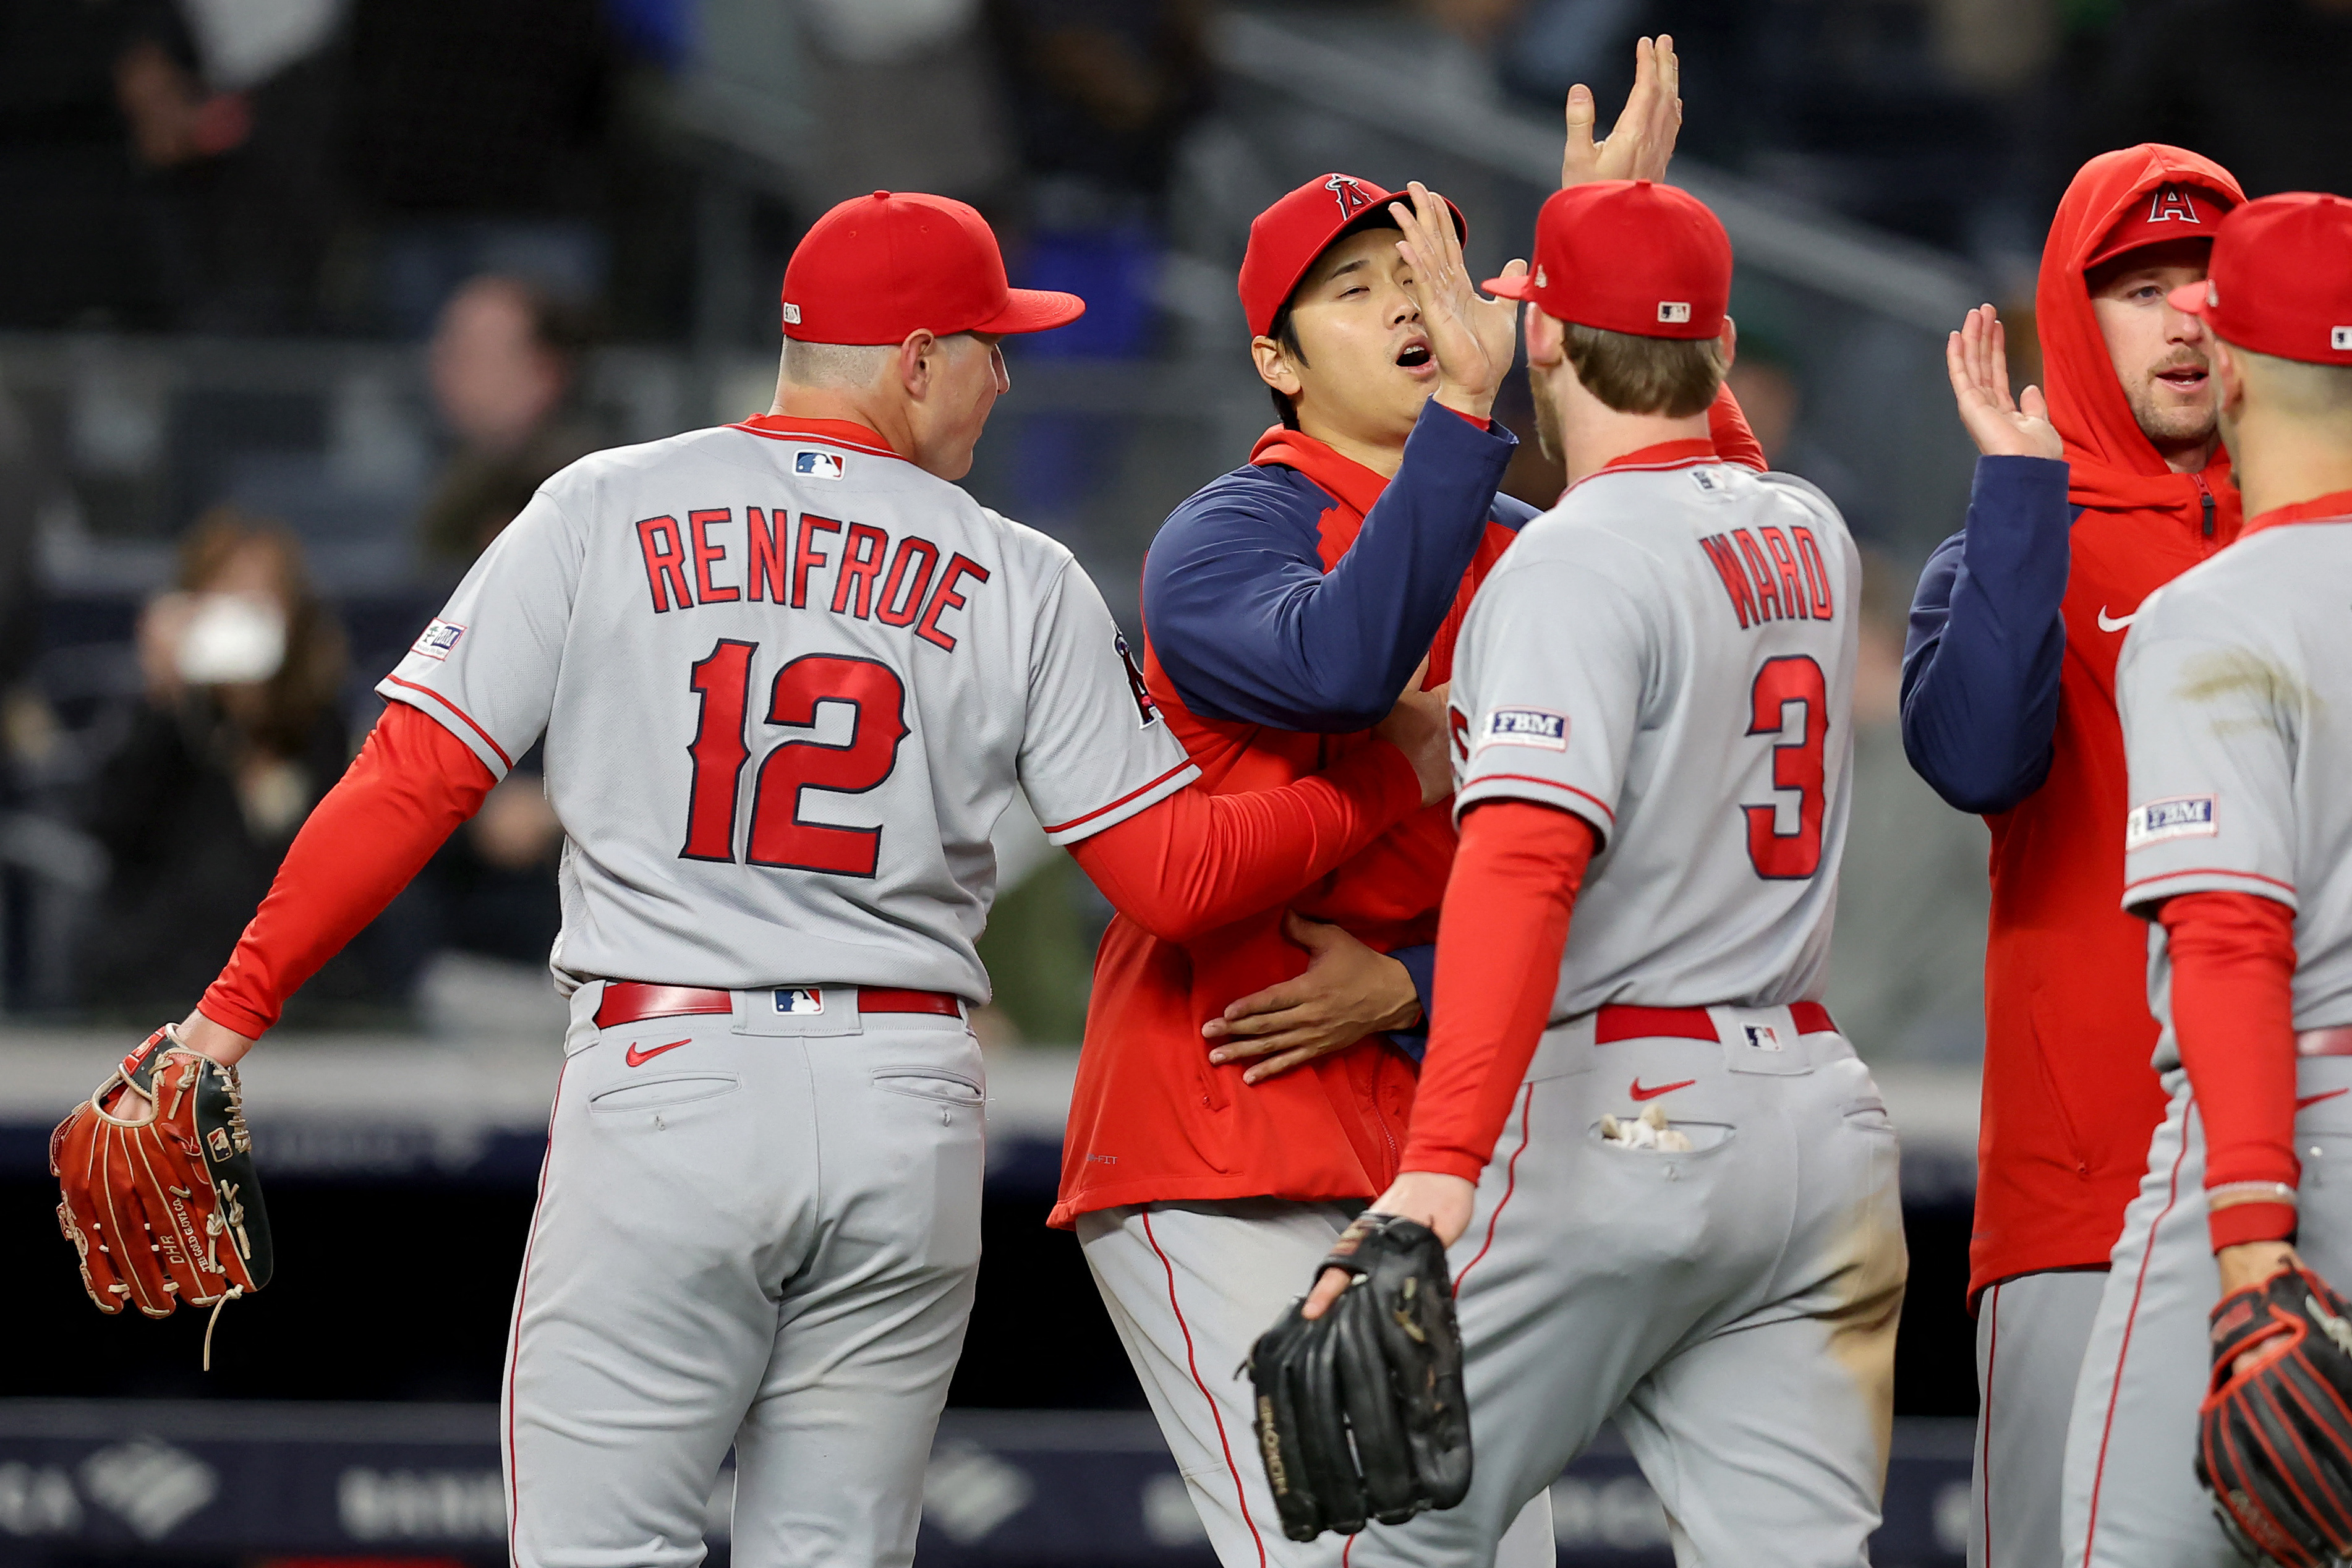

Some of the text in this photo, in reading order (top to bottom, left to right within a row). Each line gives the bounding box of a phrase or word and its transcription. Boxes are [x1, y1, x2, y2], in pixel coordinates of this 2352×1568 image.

[635, 506, 991, 654] RENFROE
[1698, 526, 1833, 629] WARD
[678, 638, 912, 879] 12
[1495, 712, 1559, 736] FBM
[1740, 654, 1829, 880] 3
[160, 1235, 185, 1264] DHR
[188, 1235, 203, 1258] GOLD
